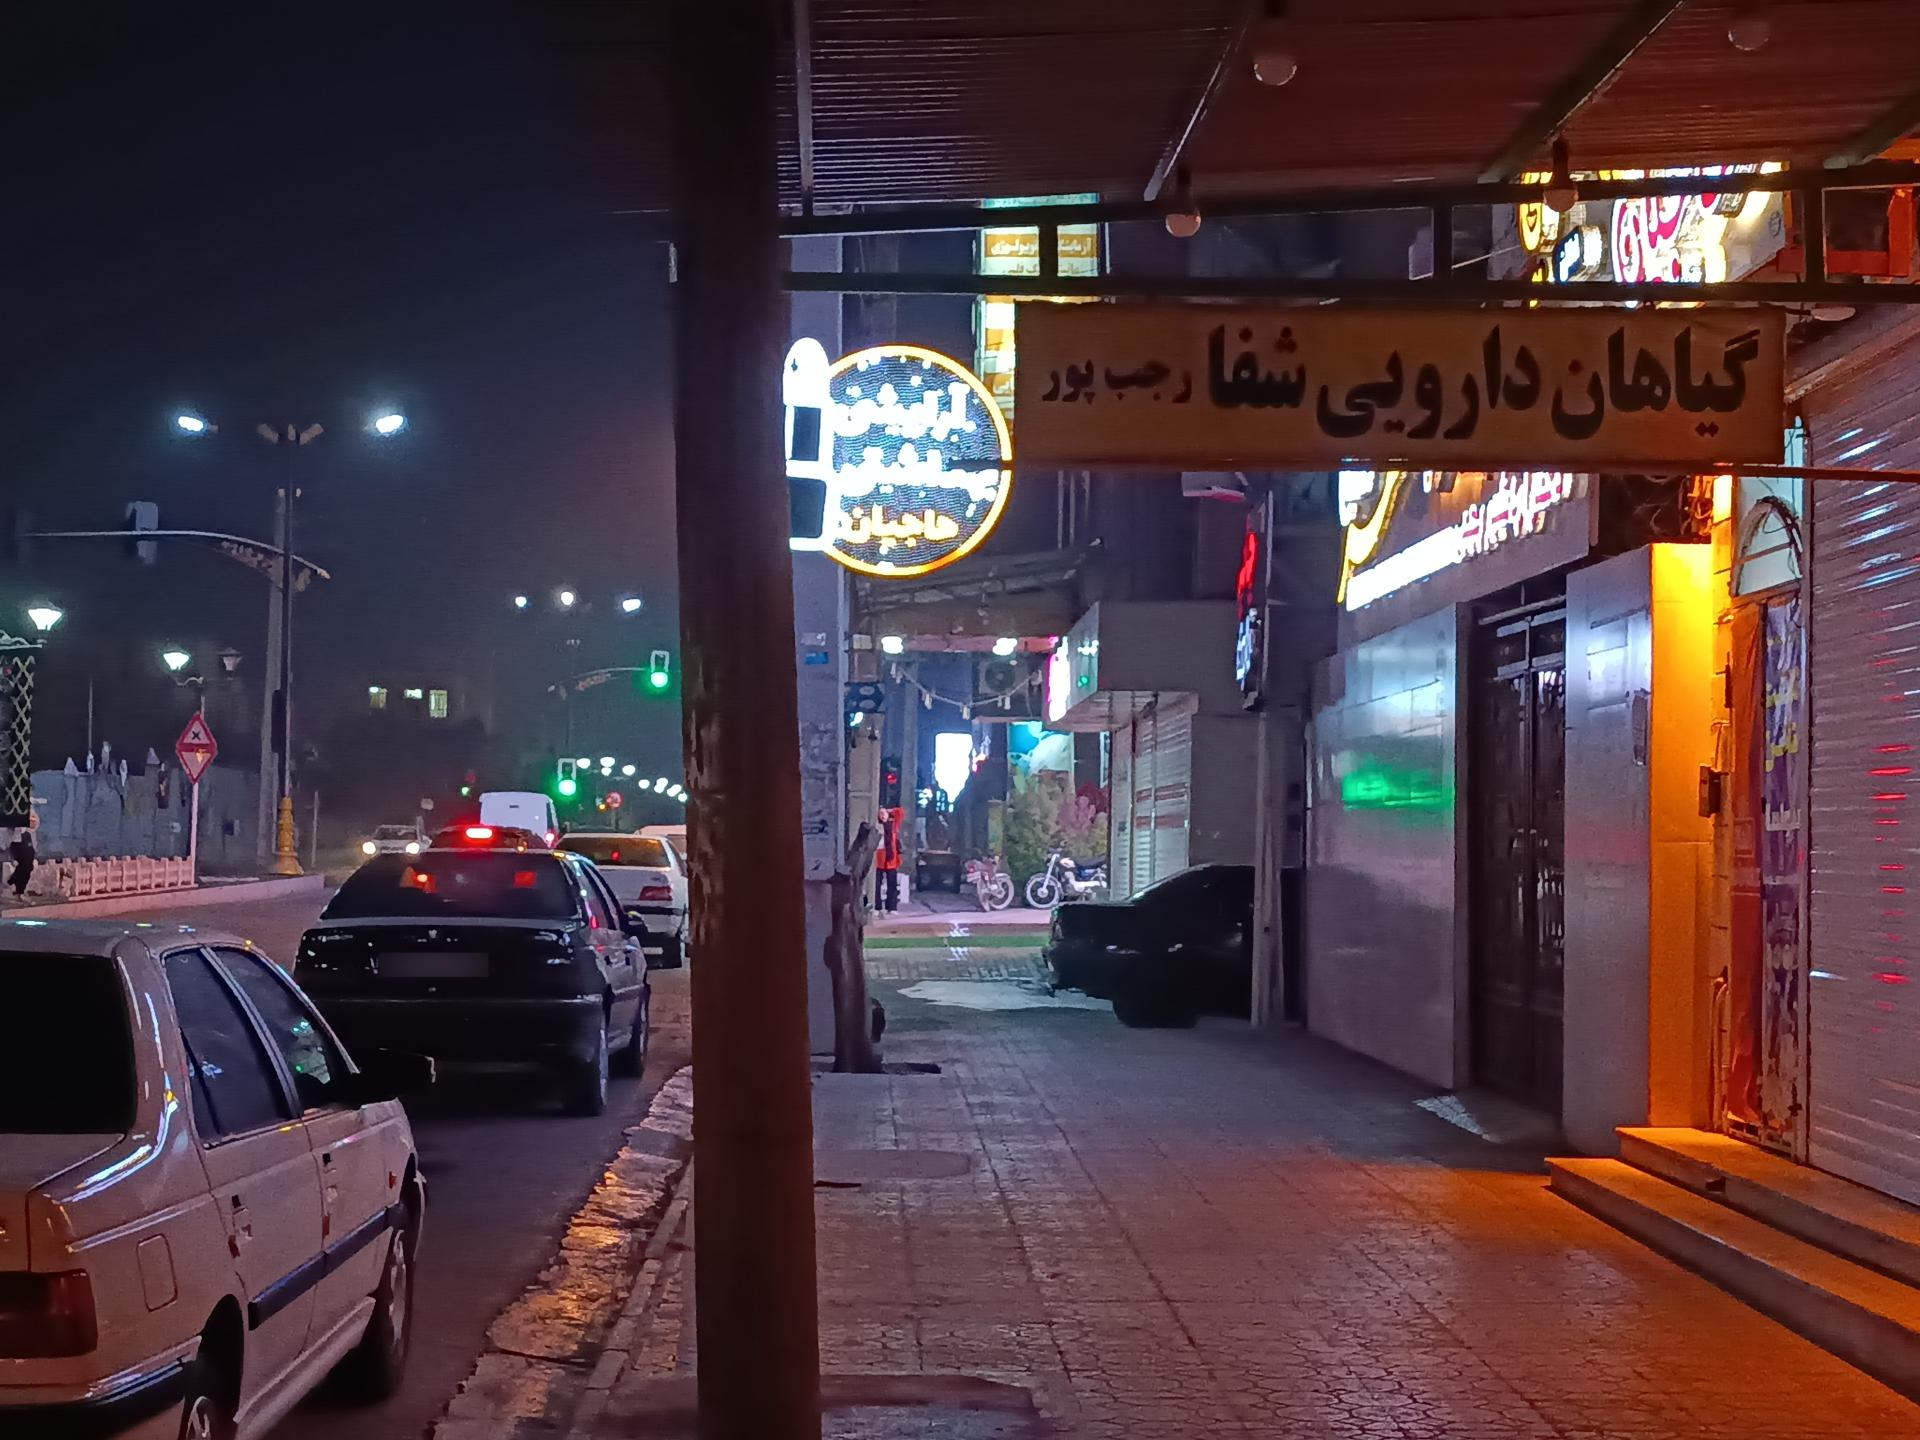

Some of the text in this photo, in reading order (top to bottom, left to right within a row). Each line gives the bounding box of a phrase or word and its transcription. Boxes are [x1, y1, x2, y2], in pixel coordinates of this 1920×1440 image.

[1207, 324, 1307, 409] شفا
[1317, 326, 1542, 441] دارویی
[1552, 324, 1761, 441] گیاهان
[843, 503, 959, 553] حاجیان
